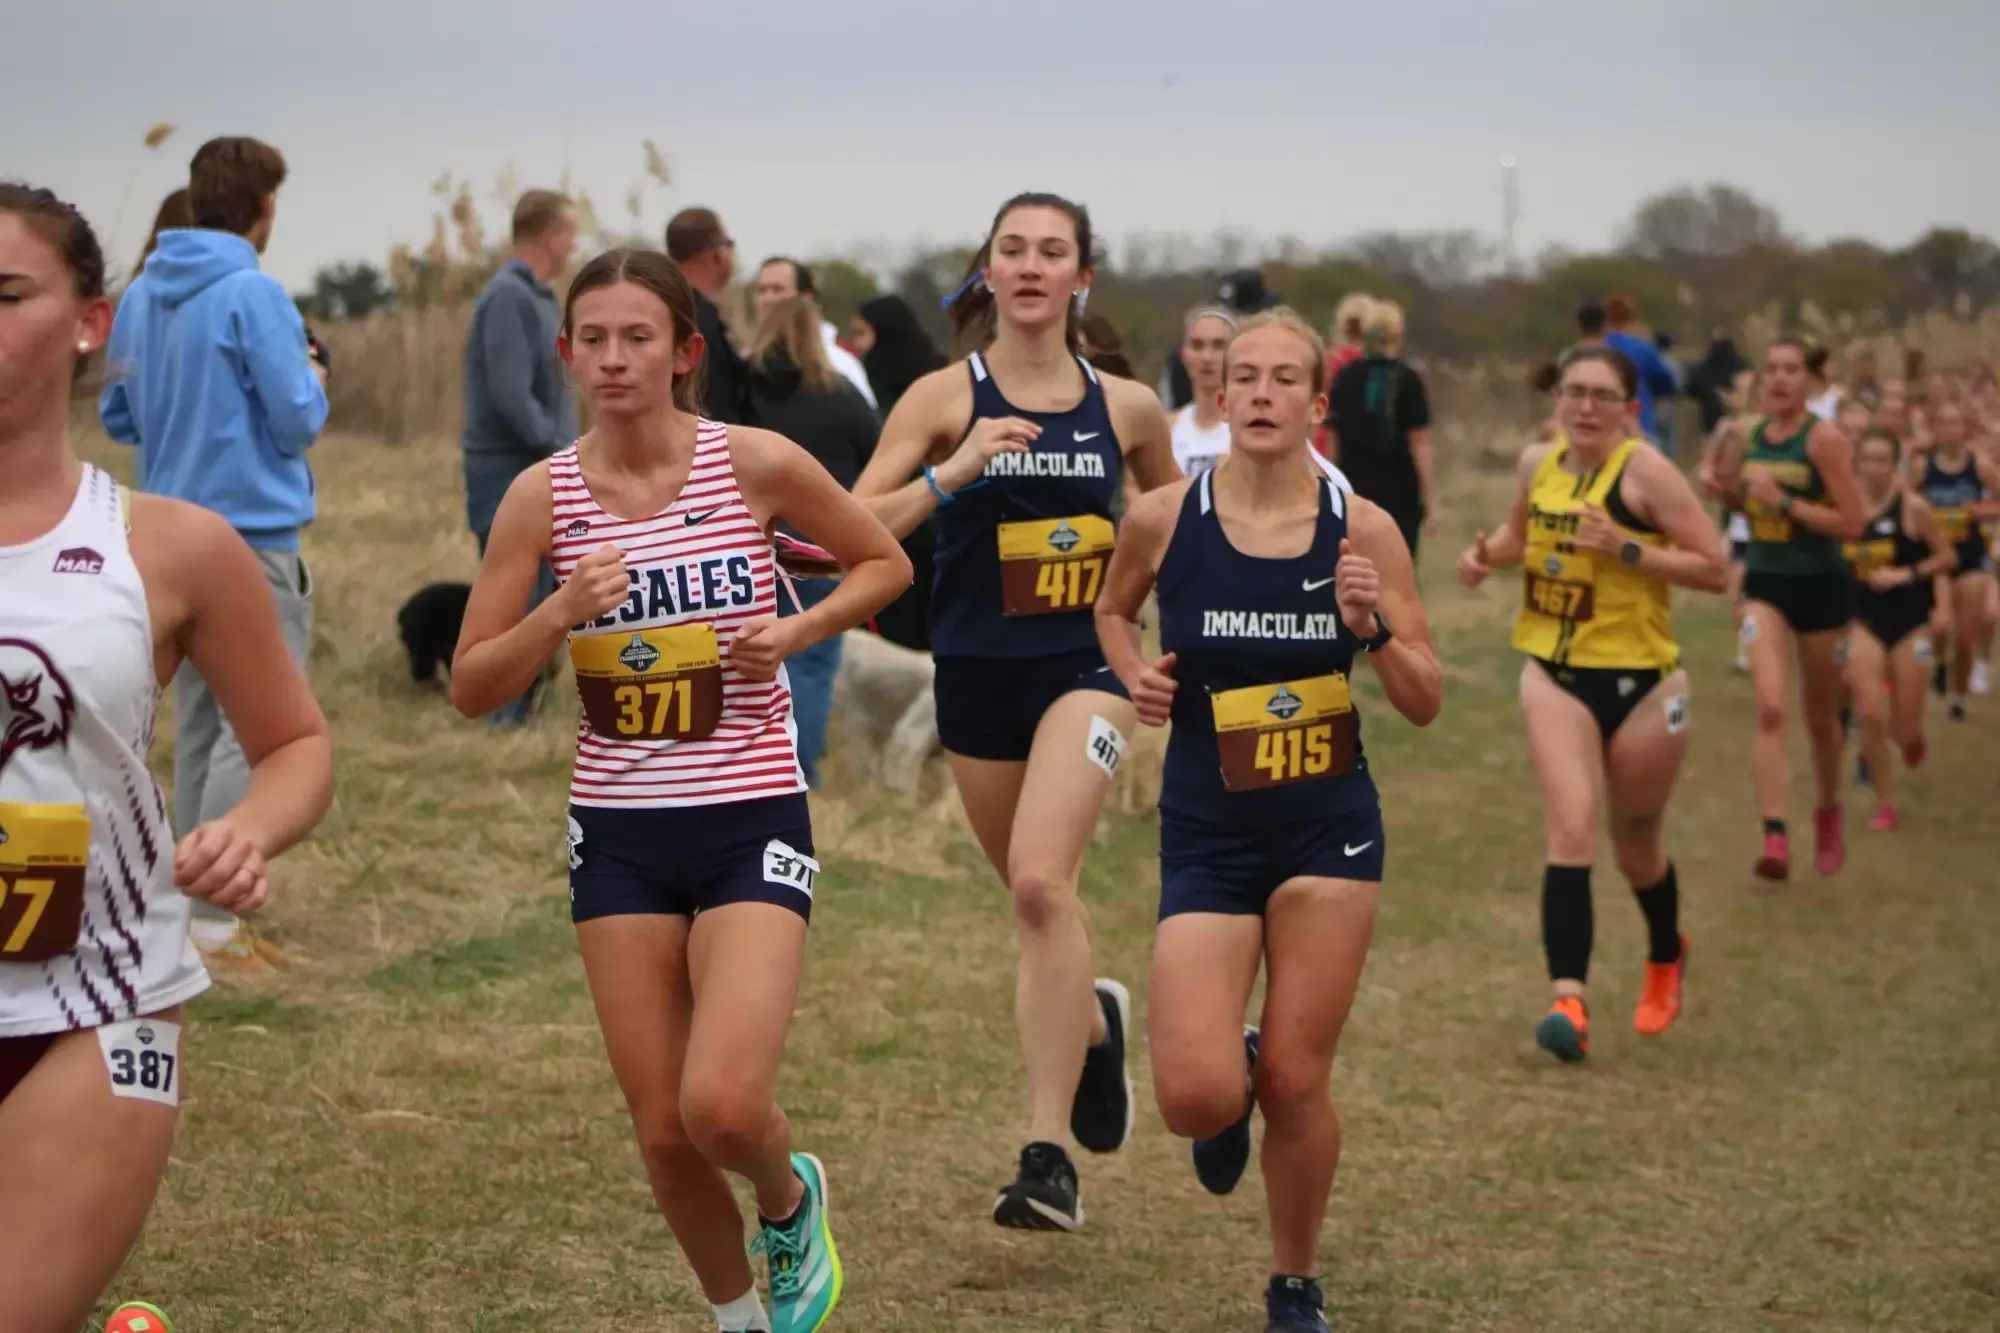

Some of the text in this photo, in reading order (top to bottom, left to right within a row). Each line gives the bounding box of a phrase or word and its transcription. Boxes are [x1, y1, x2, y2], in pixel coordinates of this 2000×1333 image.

[568, 526, 588, 537] MAC
[55, 558, 102, 573] MAC
[1035, 558, 1104, 608] 417
[562, 556, 753, 632] SALES
[1202, 610, 1338, 641] IMMACULATA
[614, 679, 693, 735] 371
[1092, 735, 1119, 770] 417
[1254, 723, 1333, 782] 415
[0, 874, 57, 952] 7
[110, 1047, 175, 1093] 387
